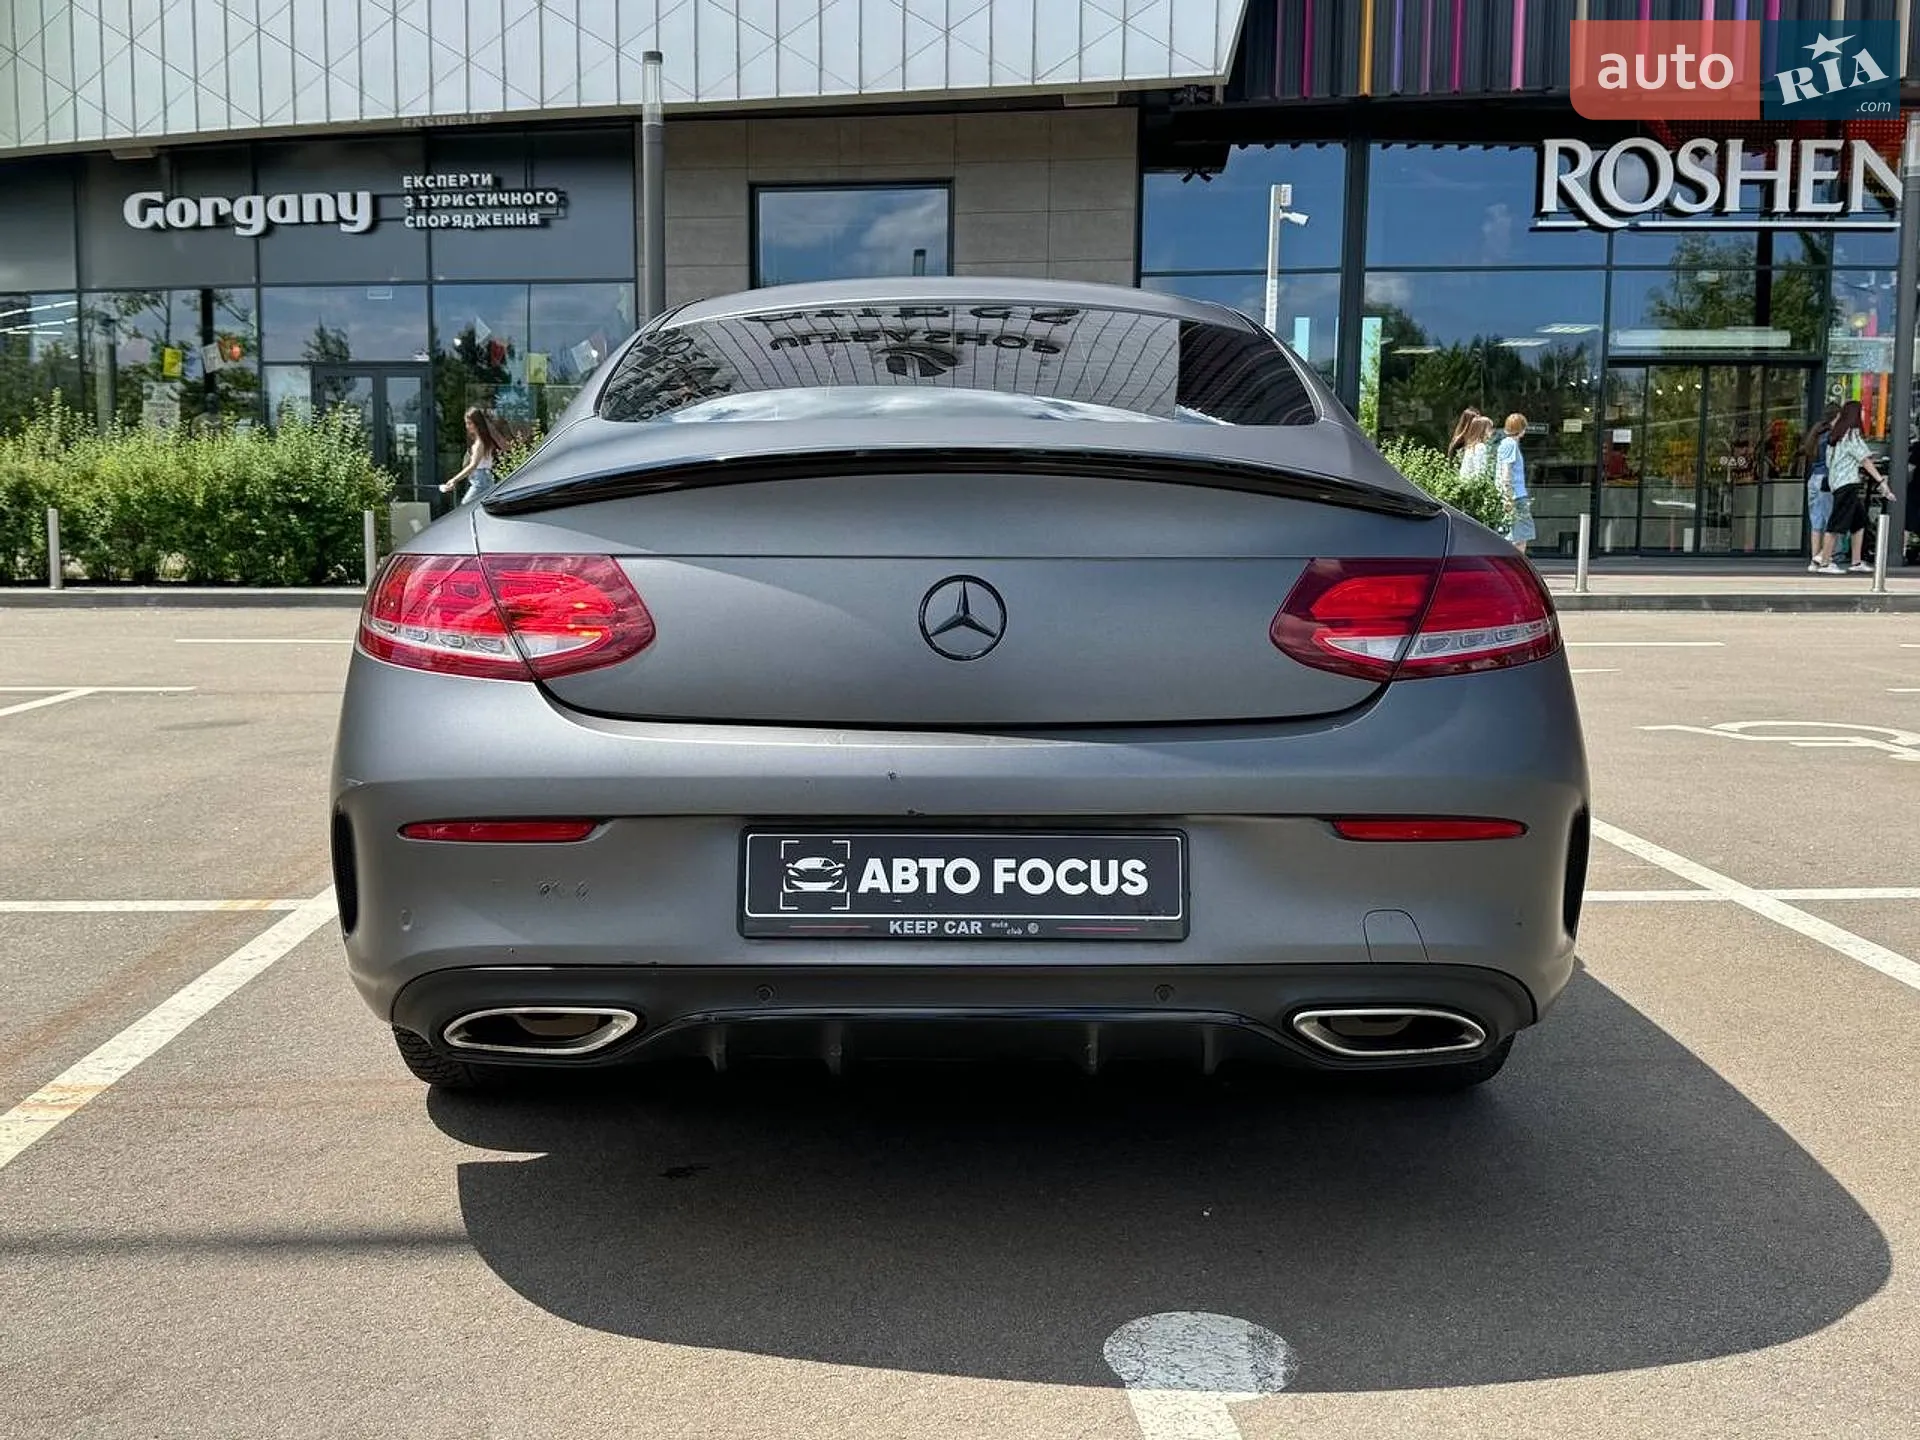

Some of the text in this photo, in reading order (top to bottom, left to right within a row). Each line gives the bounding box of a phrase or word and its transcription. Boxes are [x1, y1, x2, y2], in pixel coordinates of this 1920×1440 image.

[403, 173, 493, 188] ЕКСПЕРТИ
[1541, 137, 1902, 228] ROSHEN
[419, 191, 557, 207] ТУРИСТИЧНОГО
[123, 191, 372, 236] Gorgany
[405, 212, 540, 229] СПОРЯДЖЕННЯ
[993, 858, 1149, 896] FOCUS
[889, 920, 982, 934] KEEP CAR
